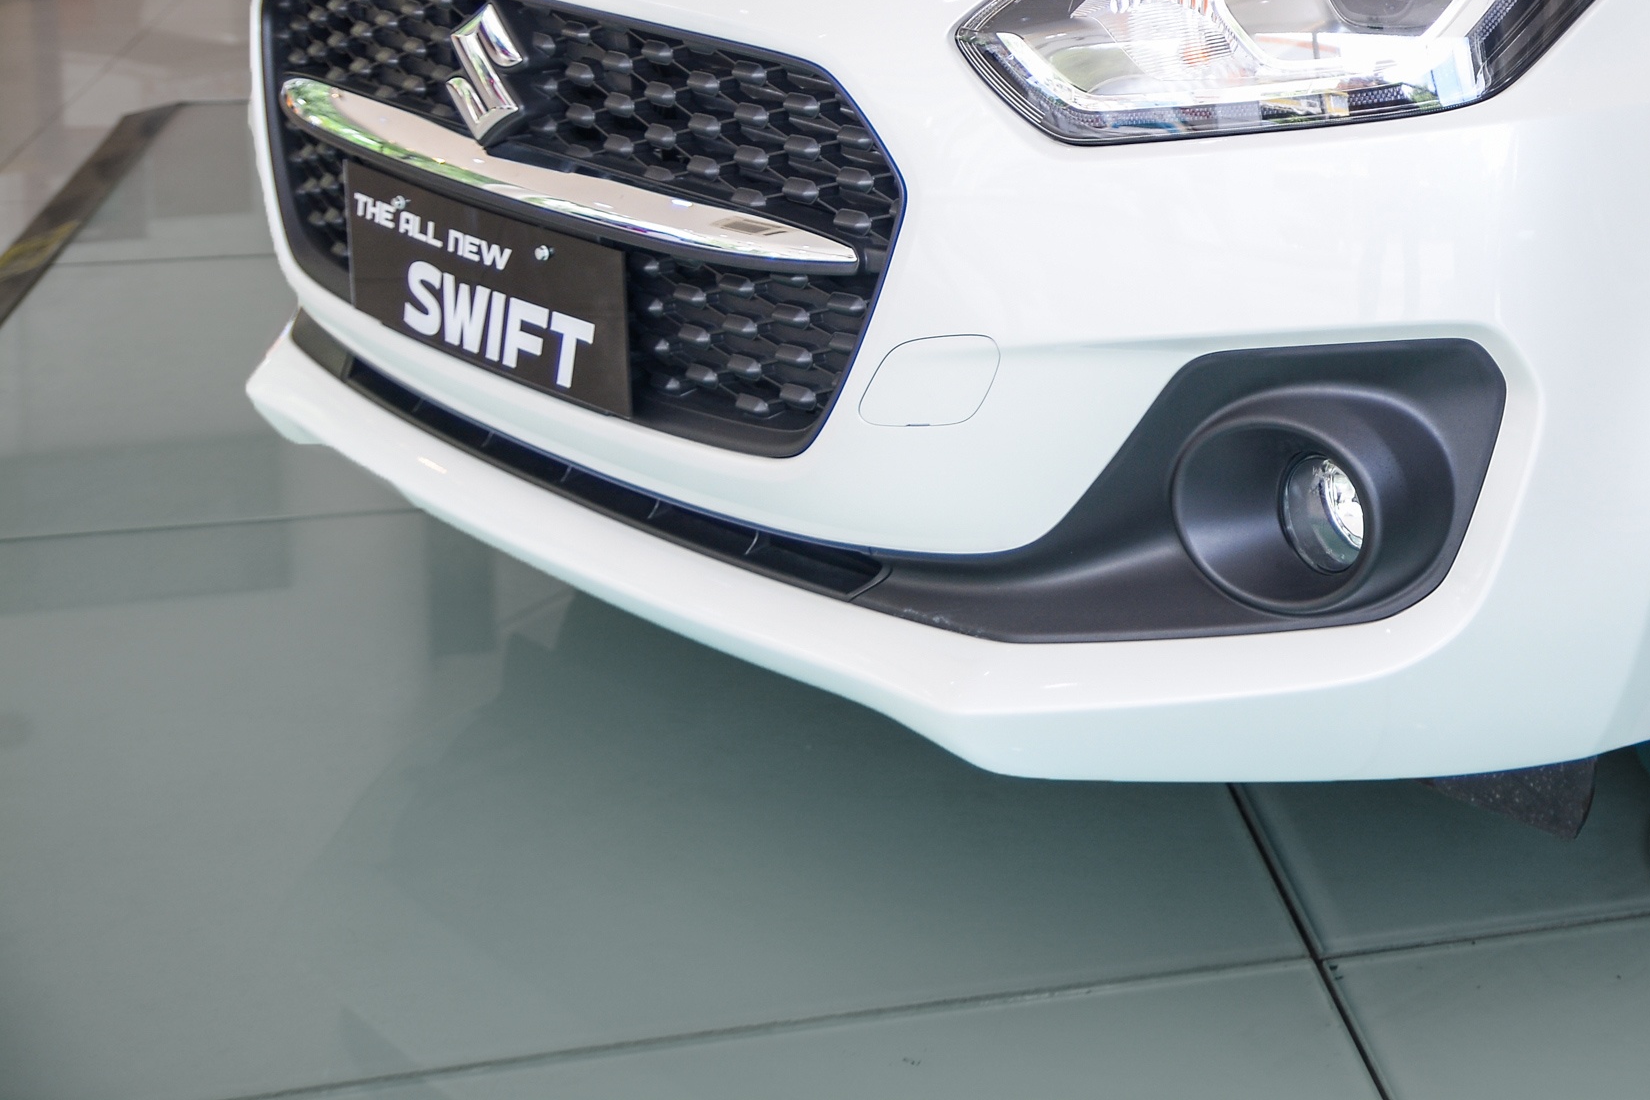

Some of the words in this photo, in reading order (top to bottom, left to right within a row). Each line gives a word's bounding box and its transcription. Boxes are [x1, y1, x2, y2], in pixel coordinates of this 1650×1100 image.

[354, 193, 396, 229] THE
[399, 211, 443, 248] ALL
[403, 260, 595, 388] SWIFT
